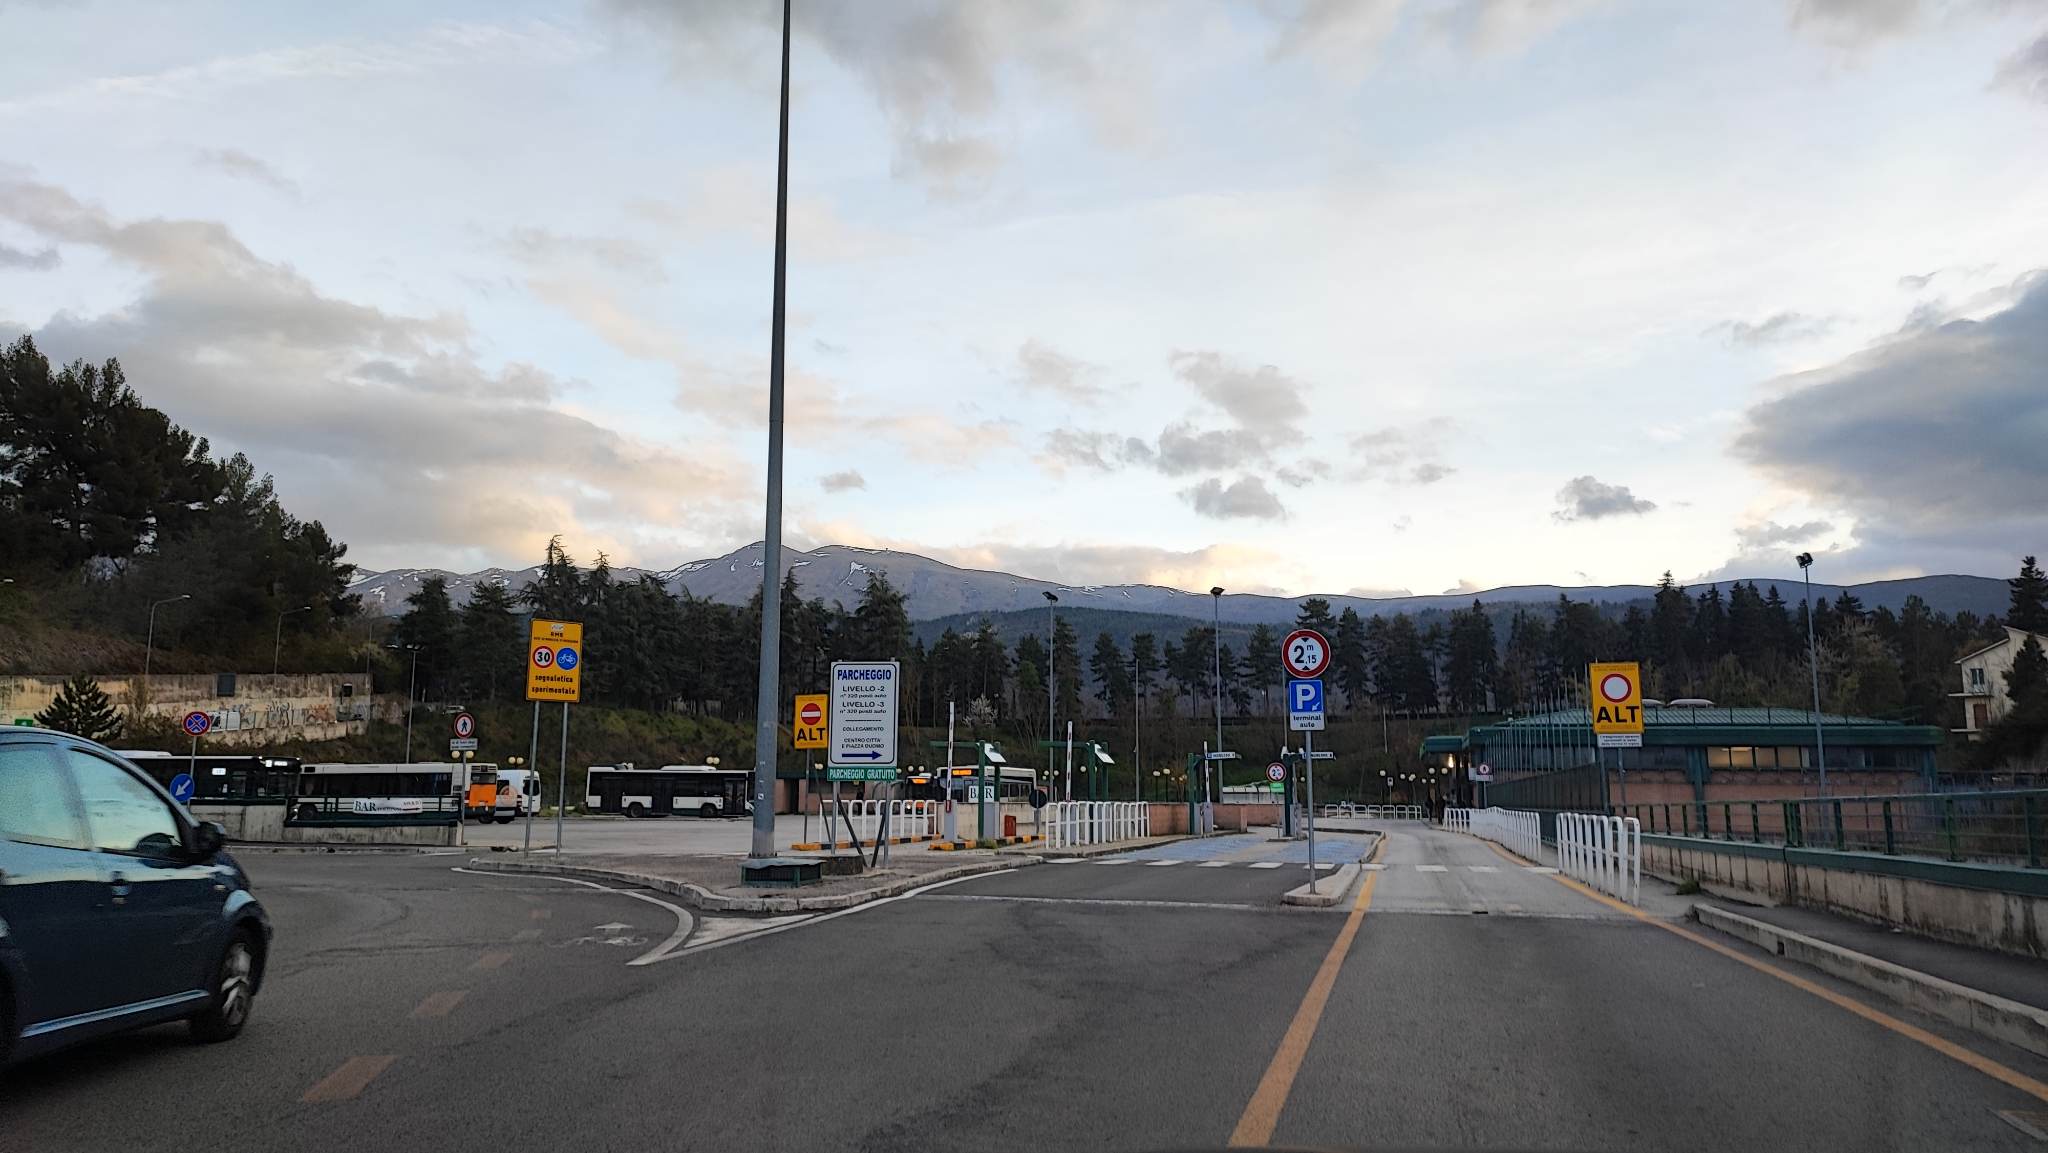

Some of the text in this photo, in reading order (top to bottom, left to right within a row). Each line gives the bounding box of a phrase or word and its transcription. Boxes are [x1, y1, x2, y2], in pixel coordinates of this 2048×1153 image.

[537, 652, 550, 662] 30
[1294, 645, 1304, 664] 2
[837, 669, 892, 681] PARCHEGGIO
[532, 687, 575, 695] sperimentale
[1296, 684, 1315, 710] P
[1596, 705, 1640, 724] ALT
[796, 727, 826, 741] ALT
[829, 768, 895, 780] PARCHEGGIO GRATUITO
[970, 787, 994, 799] BR
[354, 800, 377, 811] BAR
